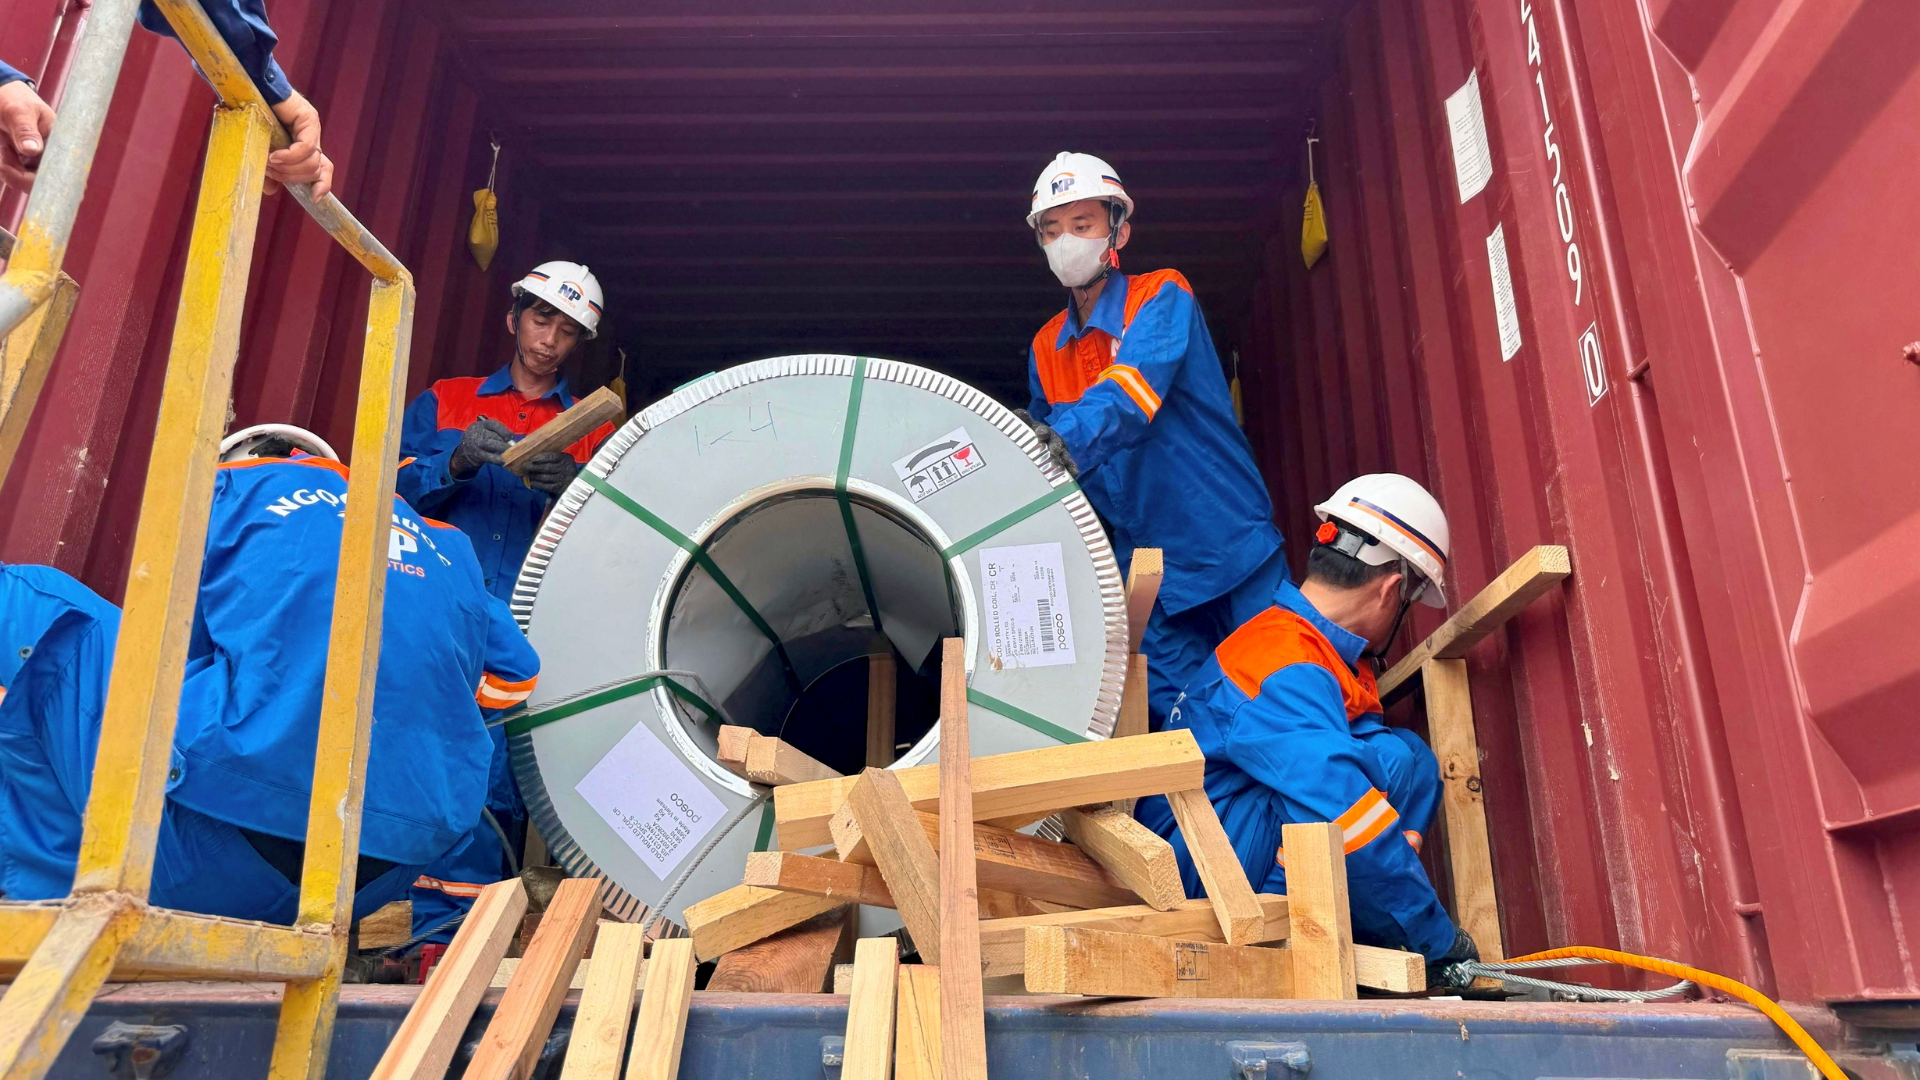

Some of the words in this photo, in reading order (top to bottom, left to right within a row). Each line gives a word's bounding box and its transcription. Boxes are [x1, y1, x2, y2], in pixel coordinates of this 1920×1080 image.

[1051, 177, 1075, 195] NP
[558, 283, 582, 302] NP
[1583, 331, 1603, 397] 0
[988, 562, 997, 577] CR
[989, 580, 996, 590] CR
[992, 610, 1000, 637] ROLLED
[1055, 613, 1069, 650] posco
[612, 806, 621, 816] CR
[656, 797, 673, 817] Vietnam
[670, 793, 702, 823] posco
[678, 820, 690, 835] Made
[632, 828, 652, 849] ROLLED
[650, 847, 665, 862] COLD
